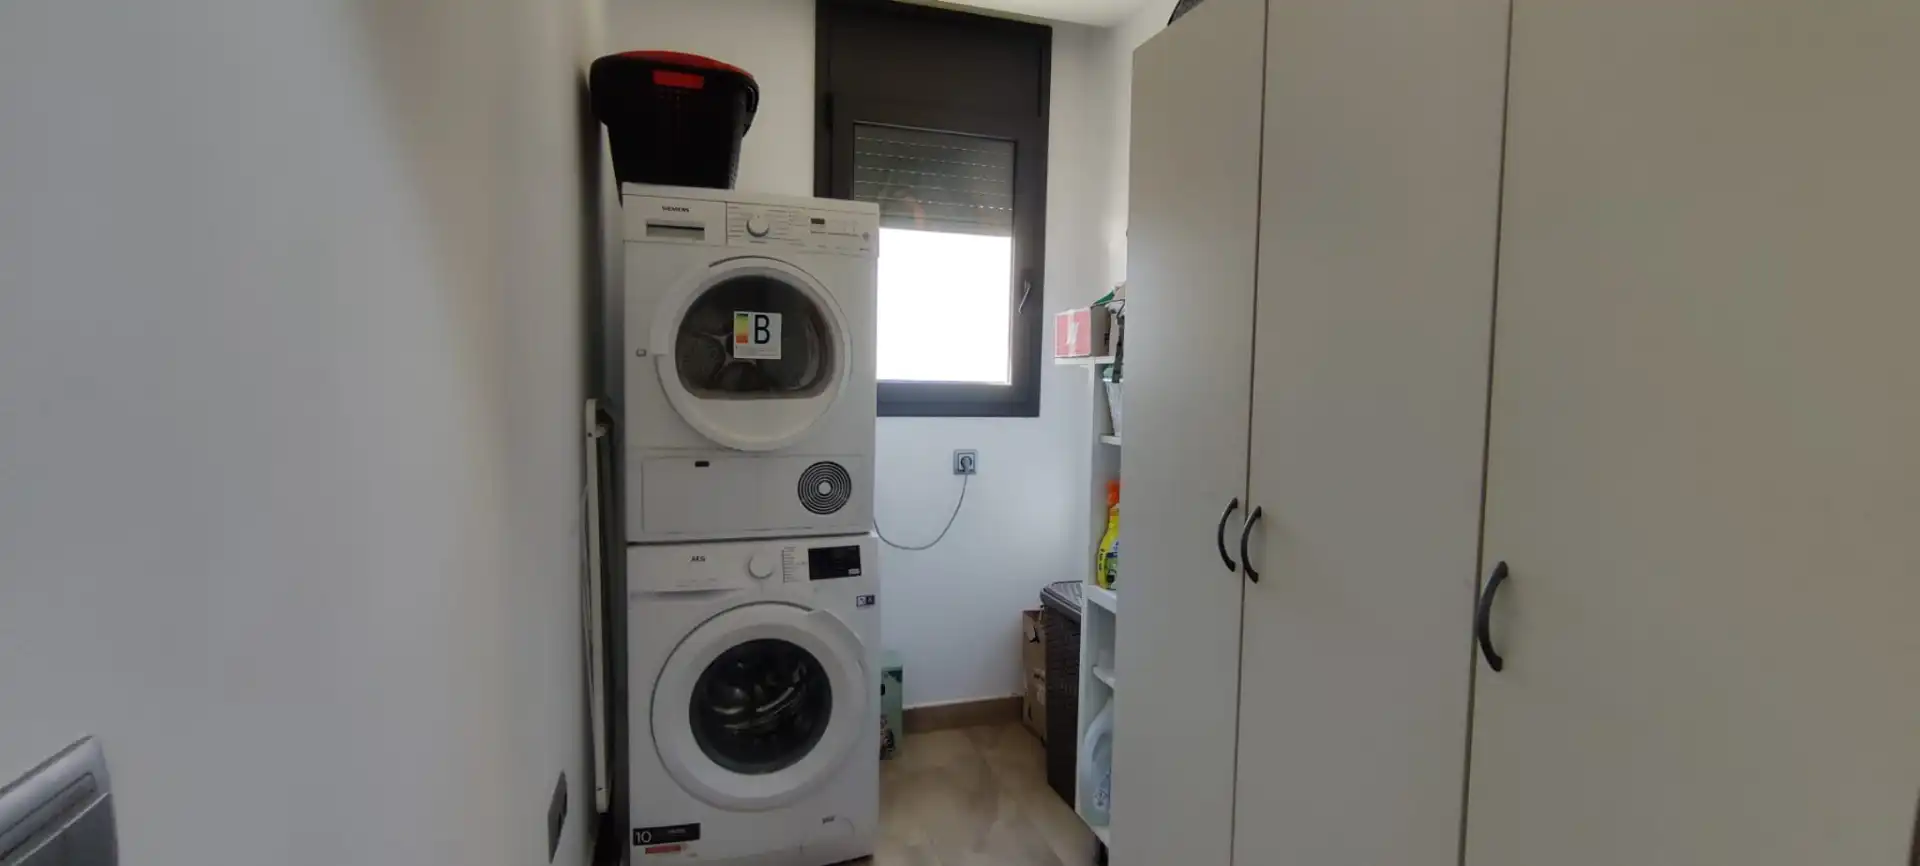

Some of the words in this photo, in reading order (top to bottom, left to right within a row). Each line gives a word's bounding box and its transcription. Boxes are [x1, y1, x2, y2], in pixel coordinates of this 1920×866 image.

[661, 205, 690, 213] SIEMENS
[754, 314, 770, 344] B
[635, 830, 652, 844] 10
